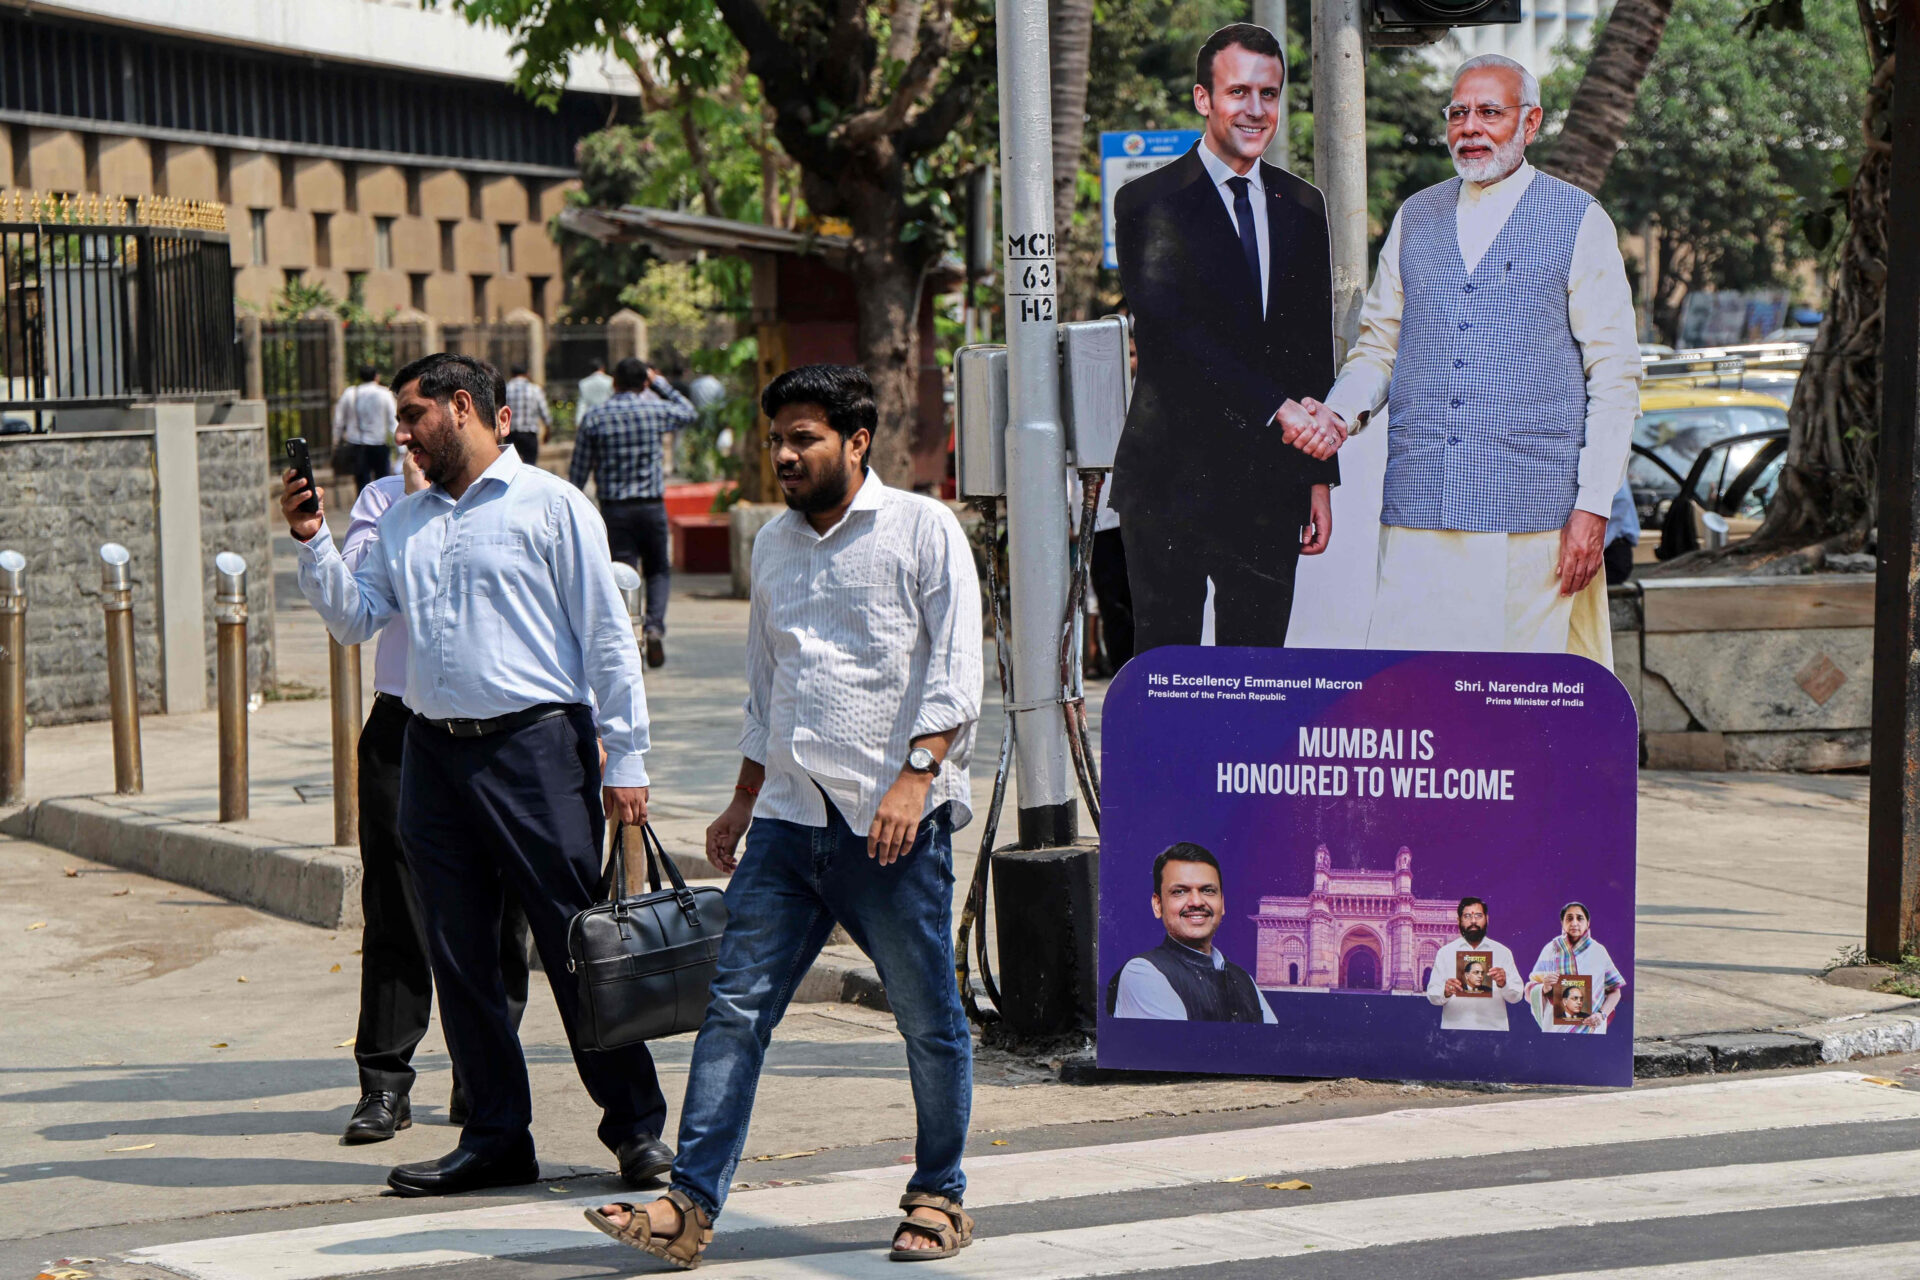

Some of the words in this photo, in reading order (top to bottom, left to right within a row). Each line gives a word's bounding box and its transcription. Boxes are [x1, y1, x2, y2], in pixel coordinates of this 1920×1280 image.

[1022, 263, 1051, 289] 63
[1021, 297, 1053, 322] H2
[1148, 673, 1169, 685] His
[1172, 674, 1241, 690] Excellency
[1244, 676, 1312, 689] Emmanuel
[1315, 677, 1363, 690] Macron
[1454, 680, 1485, 692] Shri.
[1488, 681, 1549, 693] Narendra
[1552, 682, 1584, 694] Modi
[1148, 689, 1189, 699] President
[1190, 690, 1200, 699] of
[1201, 691, 1215, 699] the
[1216, 691, 1247, 700] French
[1248, 692, 1286, 702] Republic
[1486, 697, 1512, 706] Prime
[1513, 697, 1549, 706] Minister
[1551, 697, 1561, 706] of
[1562, 698, 1584, 707] India
[1298, 726, 1403, 760] MUMBAI
[1411, 729, 1434, 761] IS
[1216, 762, 1348, 797] HONOURED
[1353, 766, 1385, 798] TO
[1390, 767, 1515, 801] WELCOME
